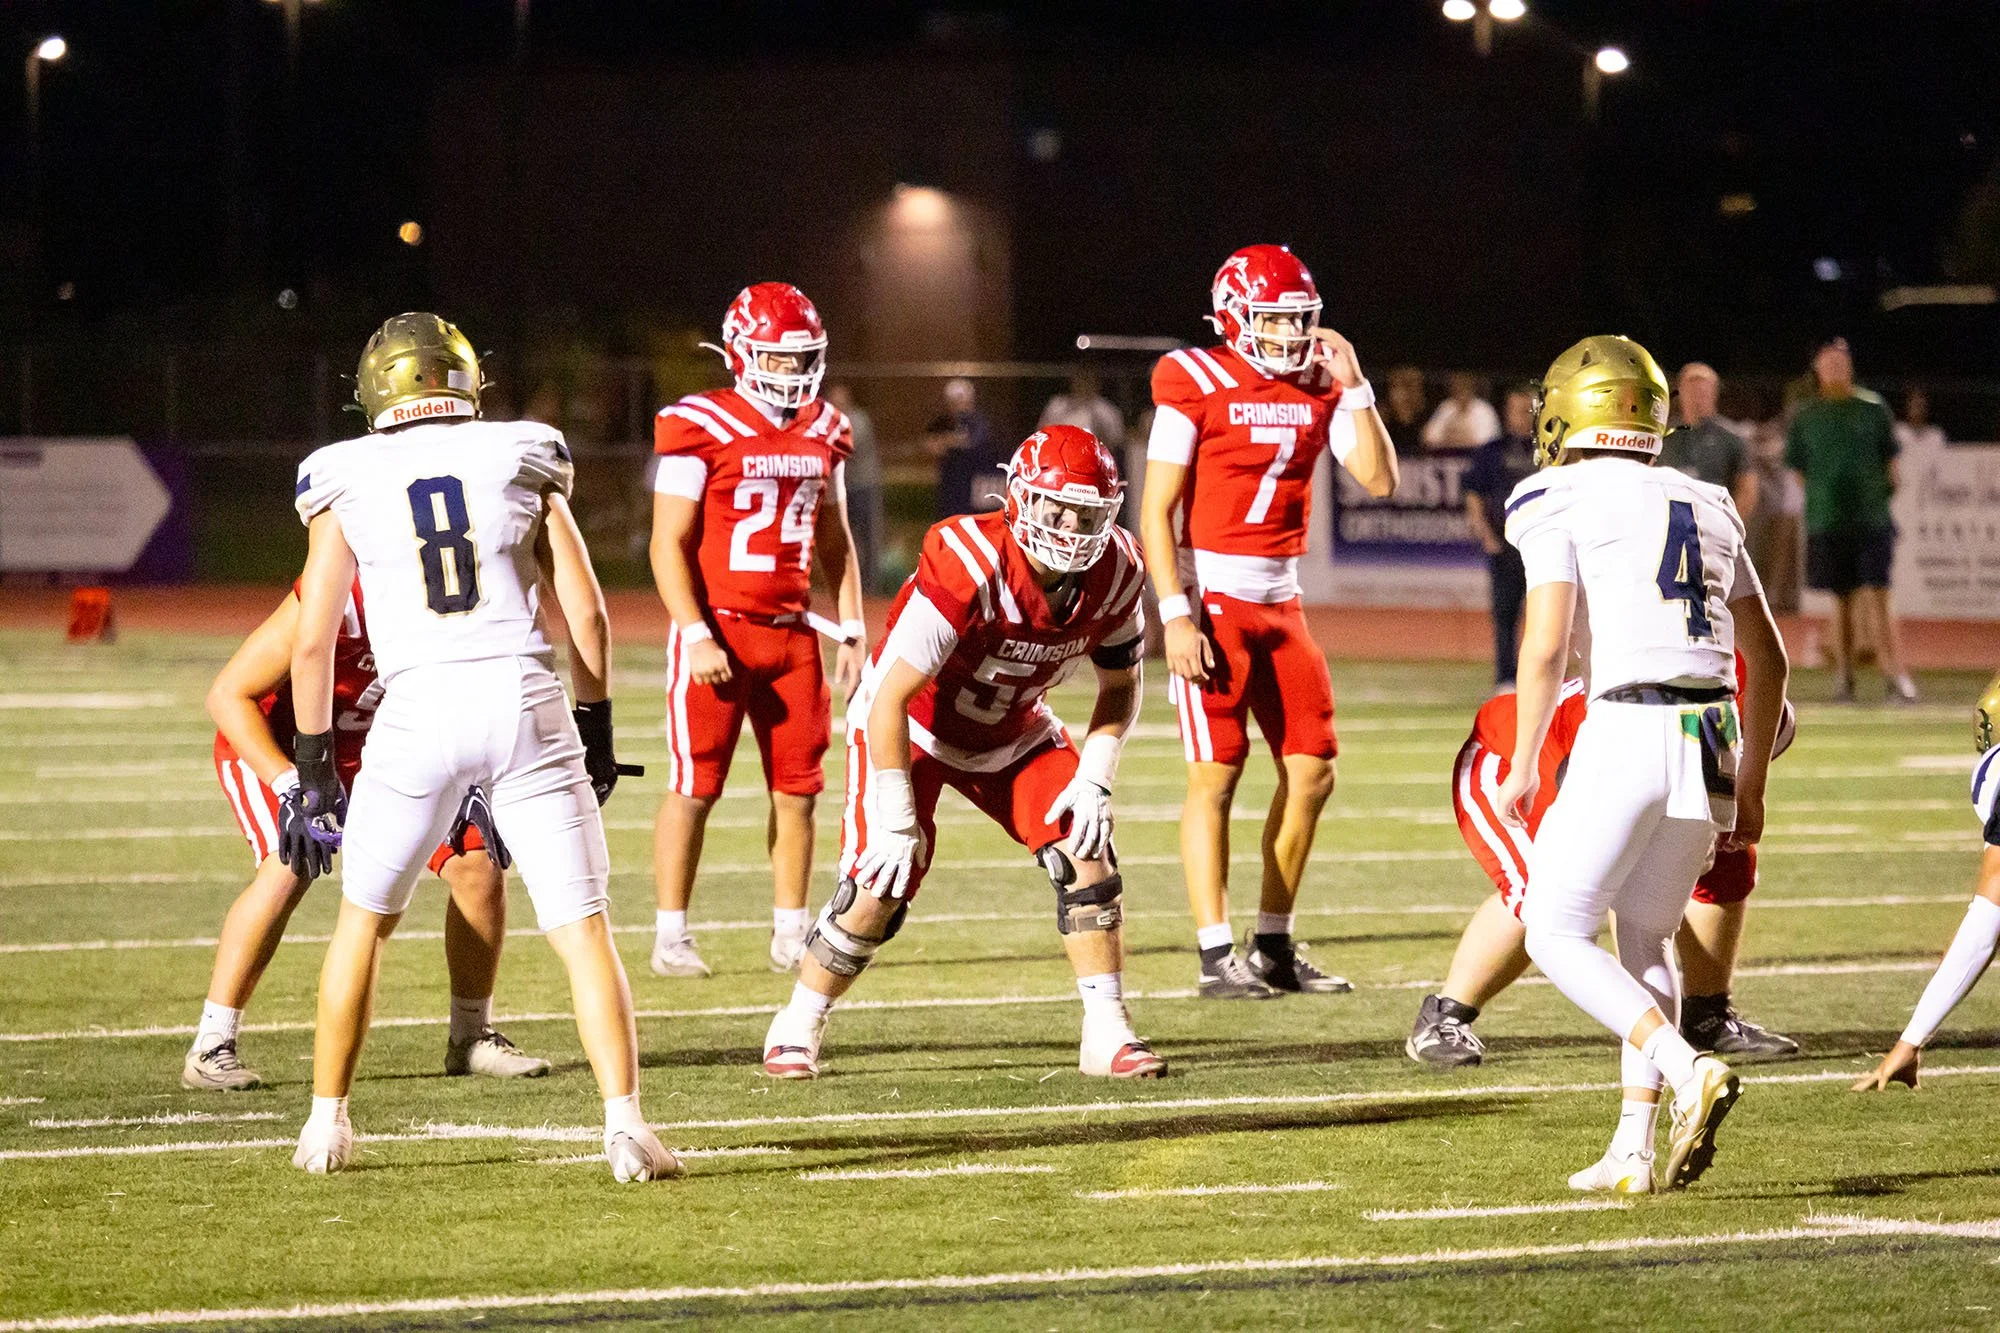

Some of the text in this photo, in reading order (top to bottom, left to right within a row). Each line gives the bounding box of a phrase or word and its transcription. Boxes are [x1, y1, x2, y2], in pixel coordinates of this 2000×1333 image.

[393, 401, 455, 421] Riddell
[1228, 402, 1312, 425] CRIMSON
[1595, 433, 1655, 450] Riddell
[742, 454, 824, 478] CRIMSON
[1244, 426, 1297, 524] 7
[729, 478, 824, 573] 24
[405, 474, 483, 617] 8
[1654, 498, 1720, 643] 4
[997, 636, 1091, 663] CRIMSON
